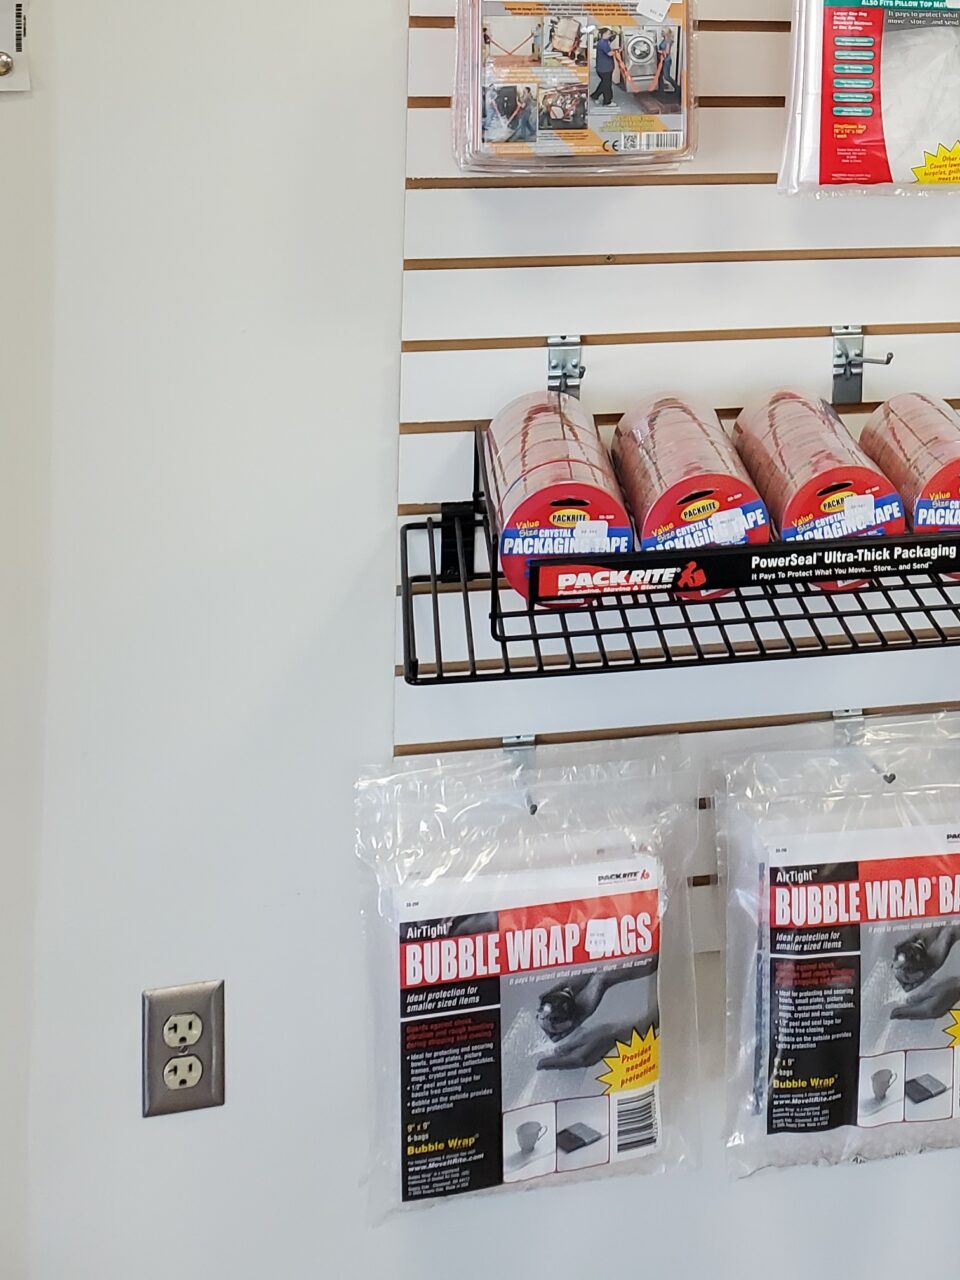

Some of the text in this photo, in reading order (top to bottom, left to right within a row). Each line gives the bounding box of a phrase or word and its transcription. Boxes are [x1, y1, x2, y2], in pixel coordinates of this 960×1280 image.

[929, 491, 951, 501] Value
[684, 502, 717, 519] PACKRITE
[516, 520, 540, 529] Value
[552, 514, 587, 522] PACKRITE
[792, 513, 814, 527] Value
[539, 529, 571, 538] CRYSTAL
[651, 522, 675, 537] Value
[824, 547, 890, 564] Ultra-Thick
[893, 544, 957, 560] Packaging
[558, 567, 677, 590] PACKRITE
[759, 572, 776, 580] Pays
[787, 569, 813, 578] Protect
[814, 568, 832, 576] What
[834, 567, 847, 575] You
[604, 585, 631, 593] Moving
[640, 583, 672, 591] Storage
[775, 882, 860, 926] BUBBLE
[865, 877, 932, 920] WRAP
[776, 931, 840, 943] Ideal protection for
[406, 912, 652, 986] BUBBLE WRAP AGS
[776, 940, 842, 951] smaller sized items
[406, 985, 478, 1003] Ideal protection for
[406, 995, 480, 1013] smaller sized items
[621, 1045, 652, 1064] Provides
[625, 1056, 651, 1073] needed
[773, 1079, 807, 1089] Bubble
[407, 1141, 445, 1155] Bubble
